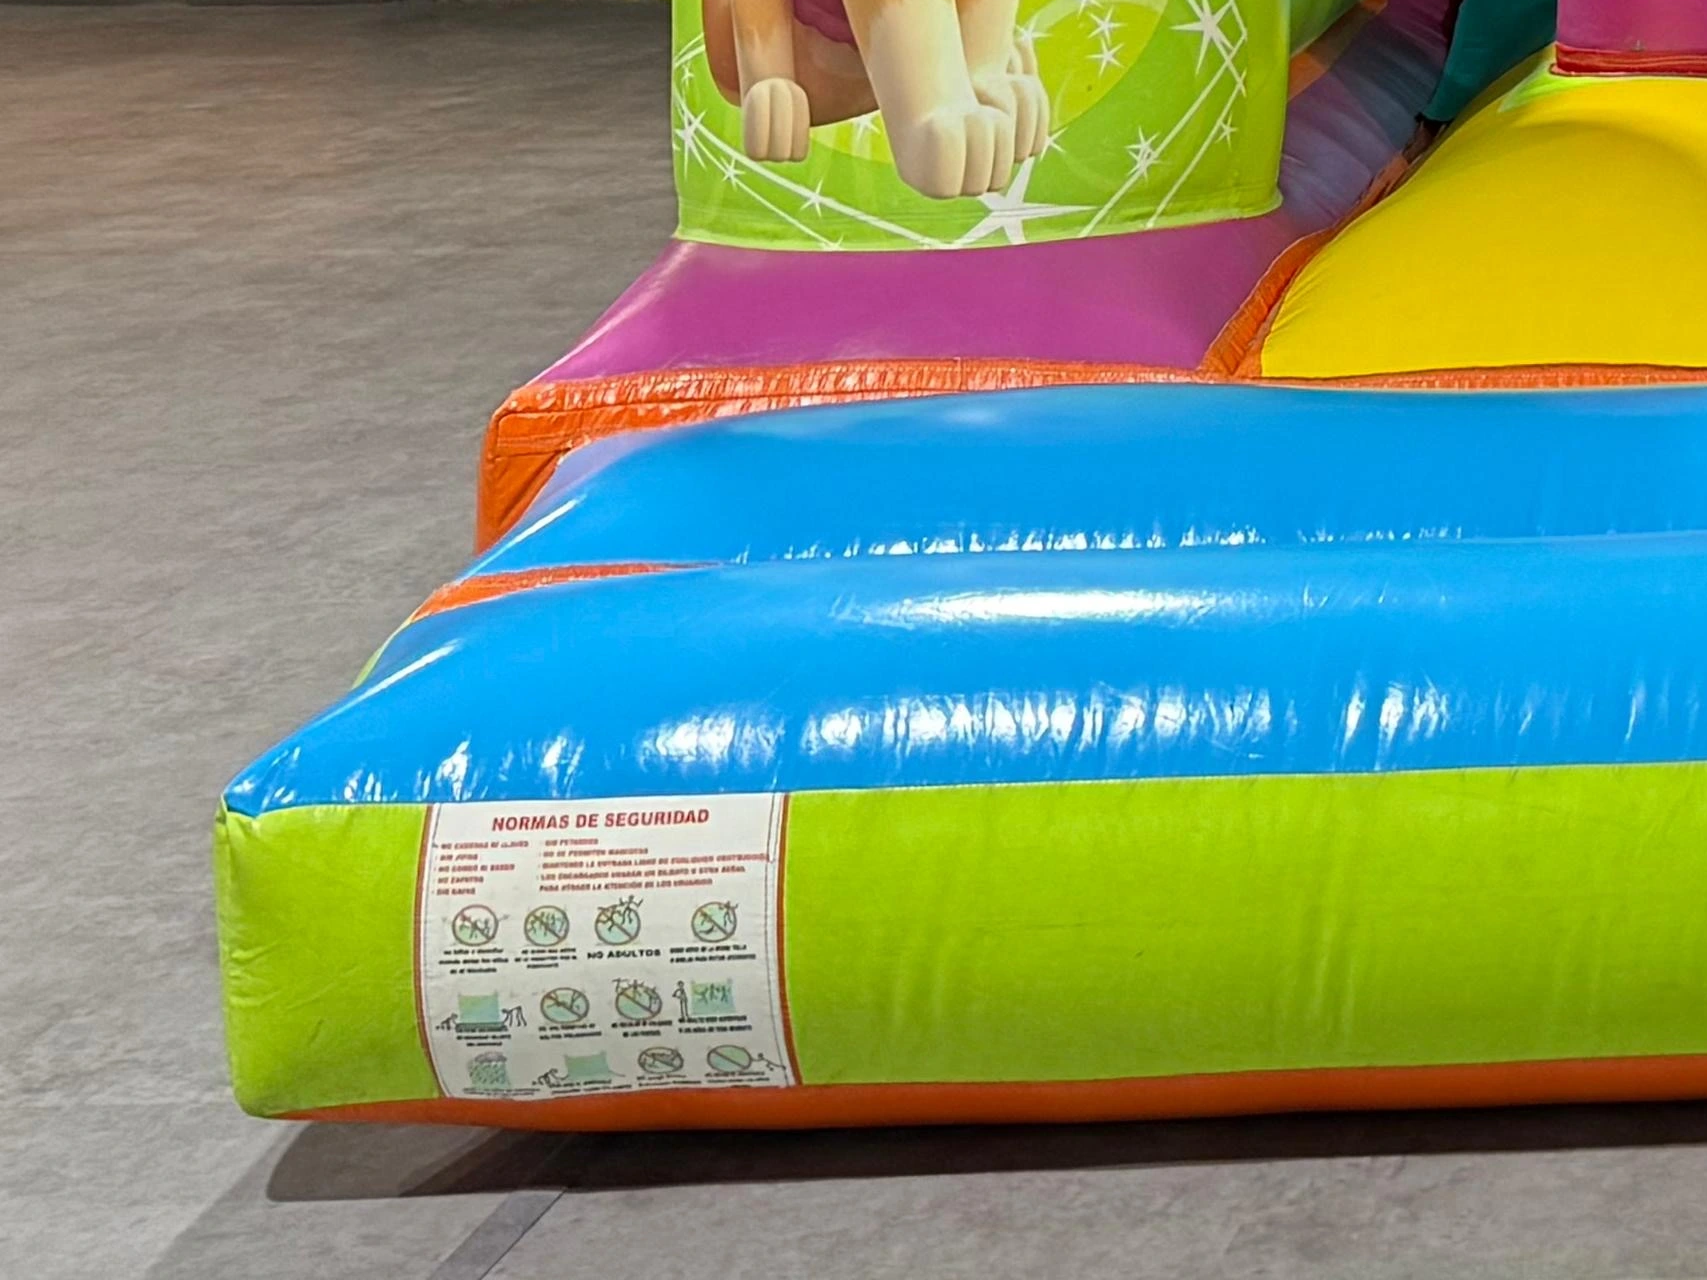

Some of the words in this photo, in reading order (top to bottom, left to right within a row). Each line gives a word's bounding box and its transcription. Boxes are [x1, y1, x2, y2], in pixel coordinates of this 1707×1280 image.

[491, 814, 570, 831] NORMAS
[576, 813, 600, 828] DE
[604, 808, 710, 827] SEGURIDAD
